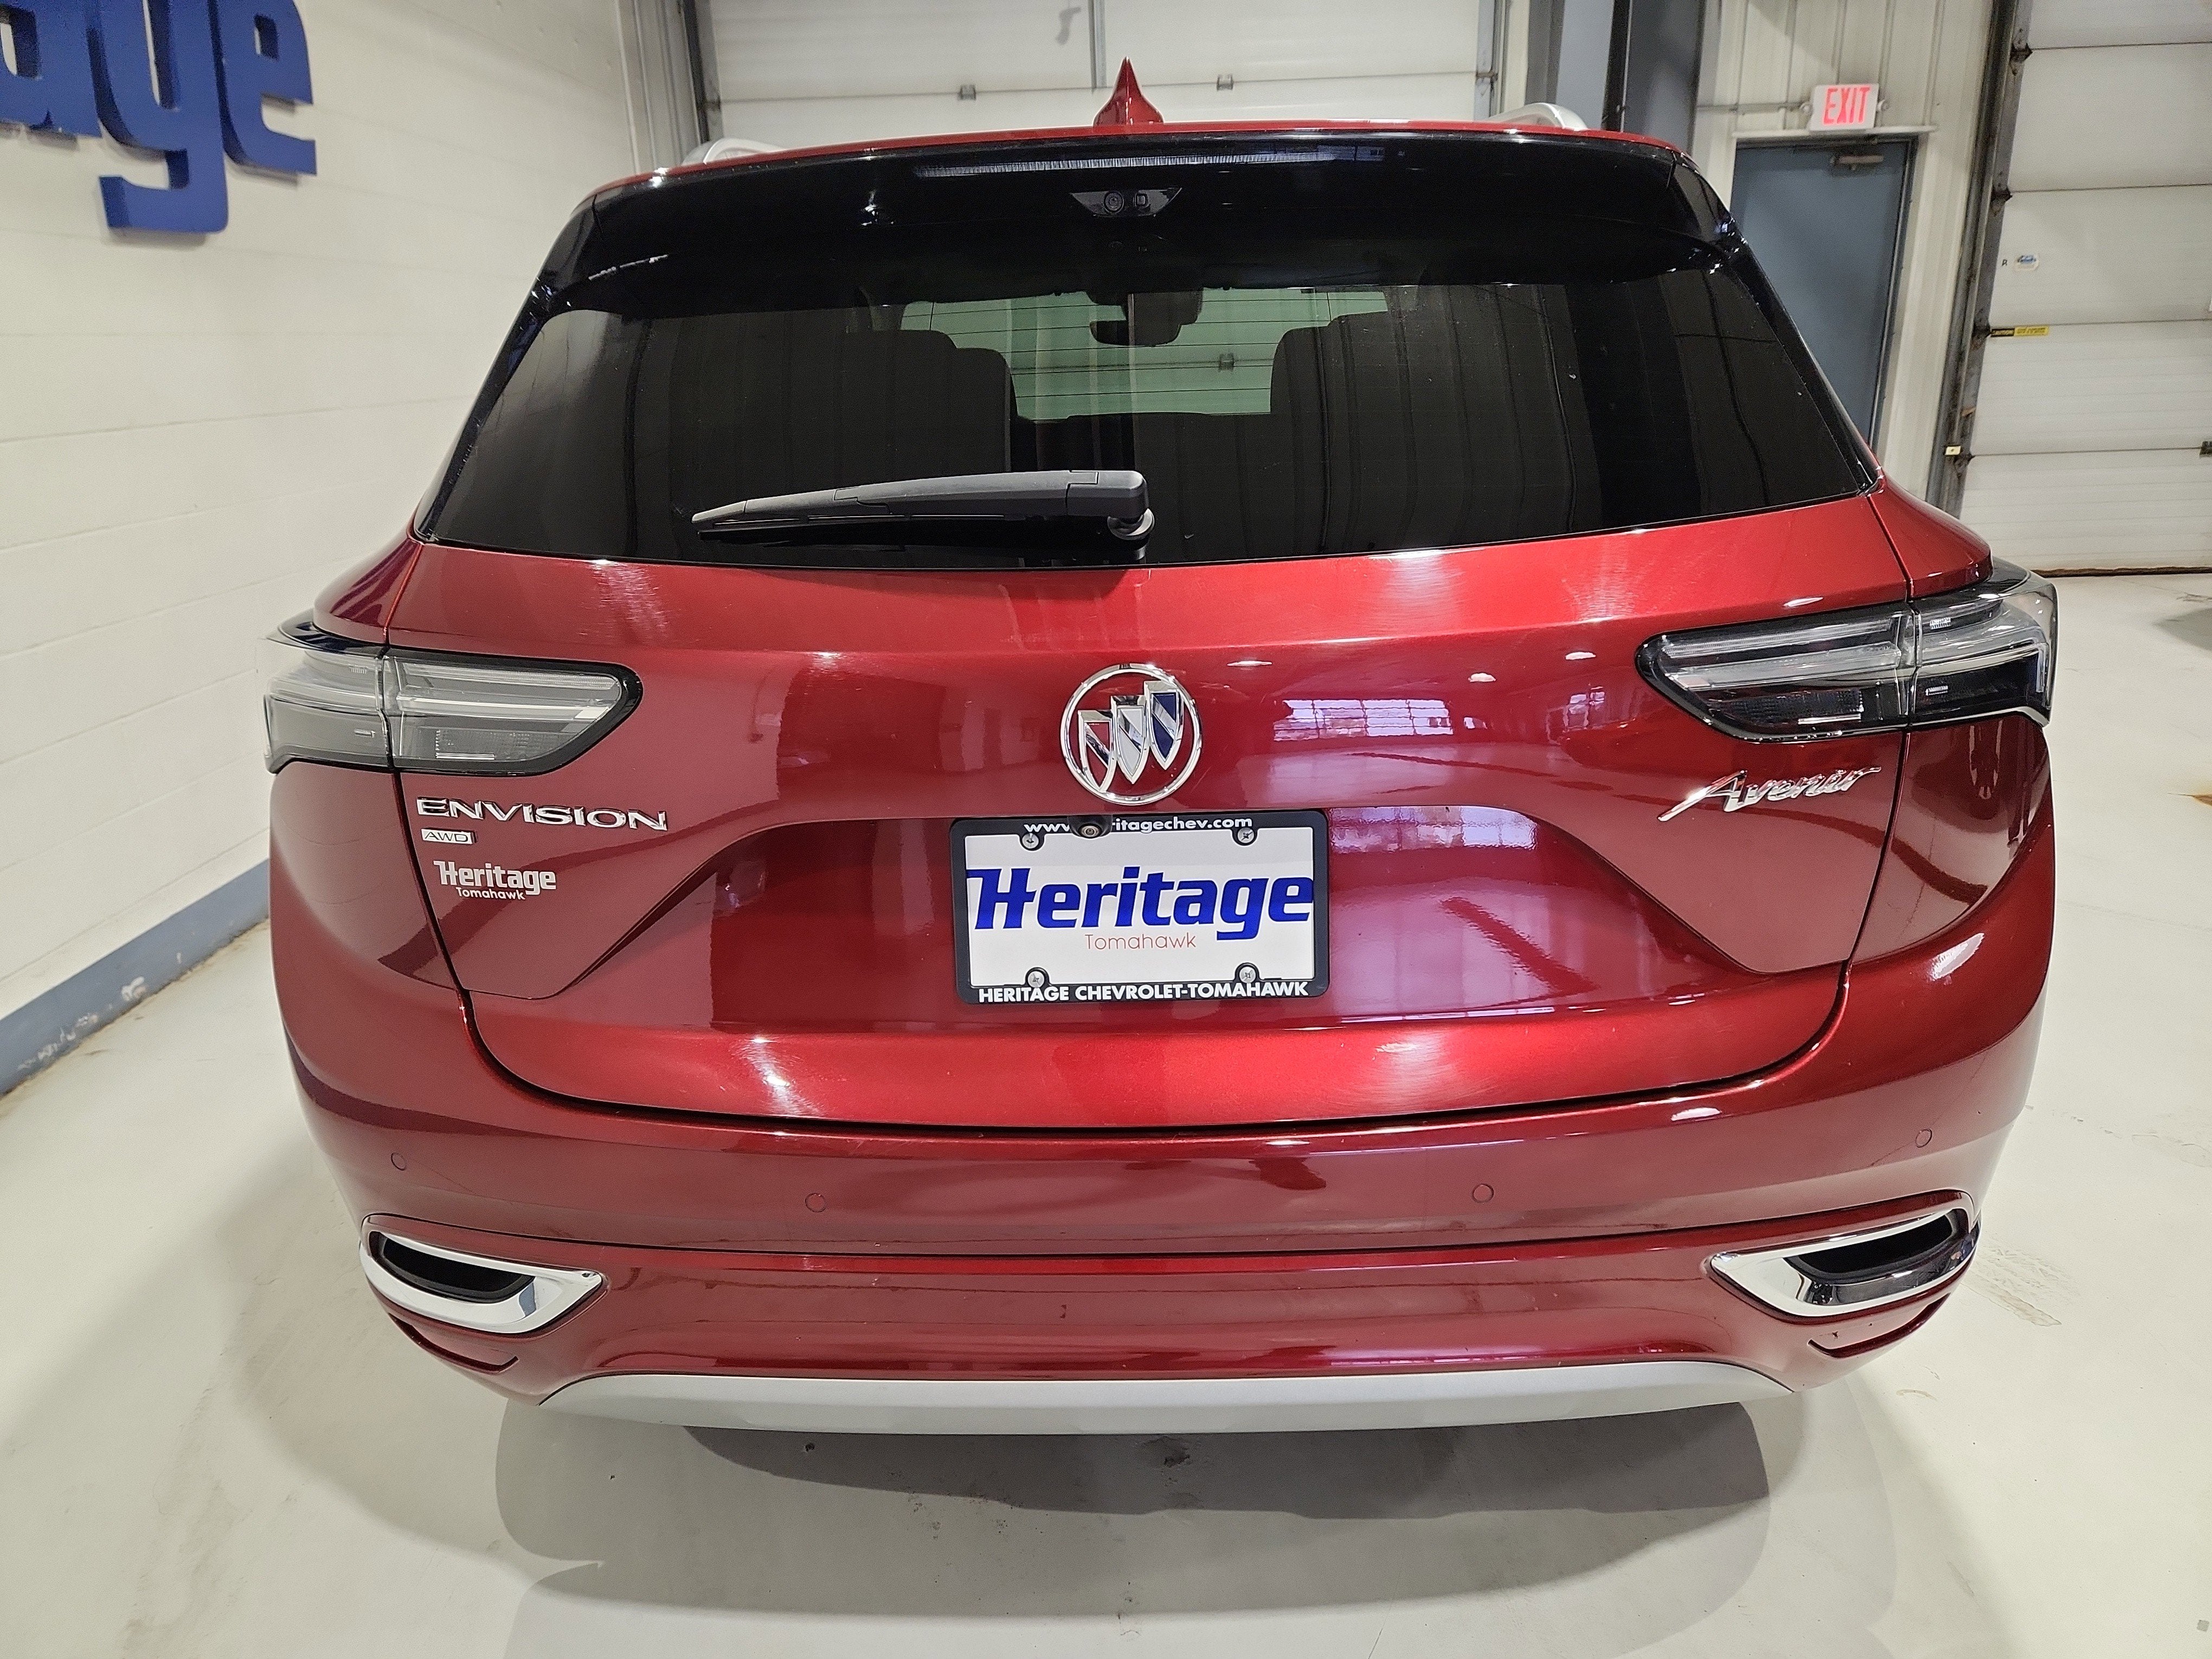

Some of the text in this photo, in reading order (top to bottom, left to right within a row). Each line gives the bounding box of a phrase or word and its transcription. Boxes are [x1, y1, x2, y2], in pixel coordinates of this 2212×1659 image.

[1823, 86, 1871, 125] EXIT
[416, 797, 668, 831] ENVISION
[1024, 816, 1253, 834] wwitagechev.com
[425, 831, 469, 843] AWD
[433, 860, 556, 895] Heritage
[456, 886, 526, 901] Tomahawk
[966, 866, 1313, 940] Heritage
[1084, 932, 1196, 950] Tomahawk
[979, 981, 1308, 1002] HERITAGE CHEVROLET-TOMAHAWK
